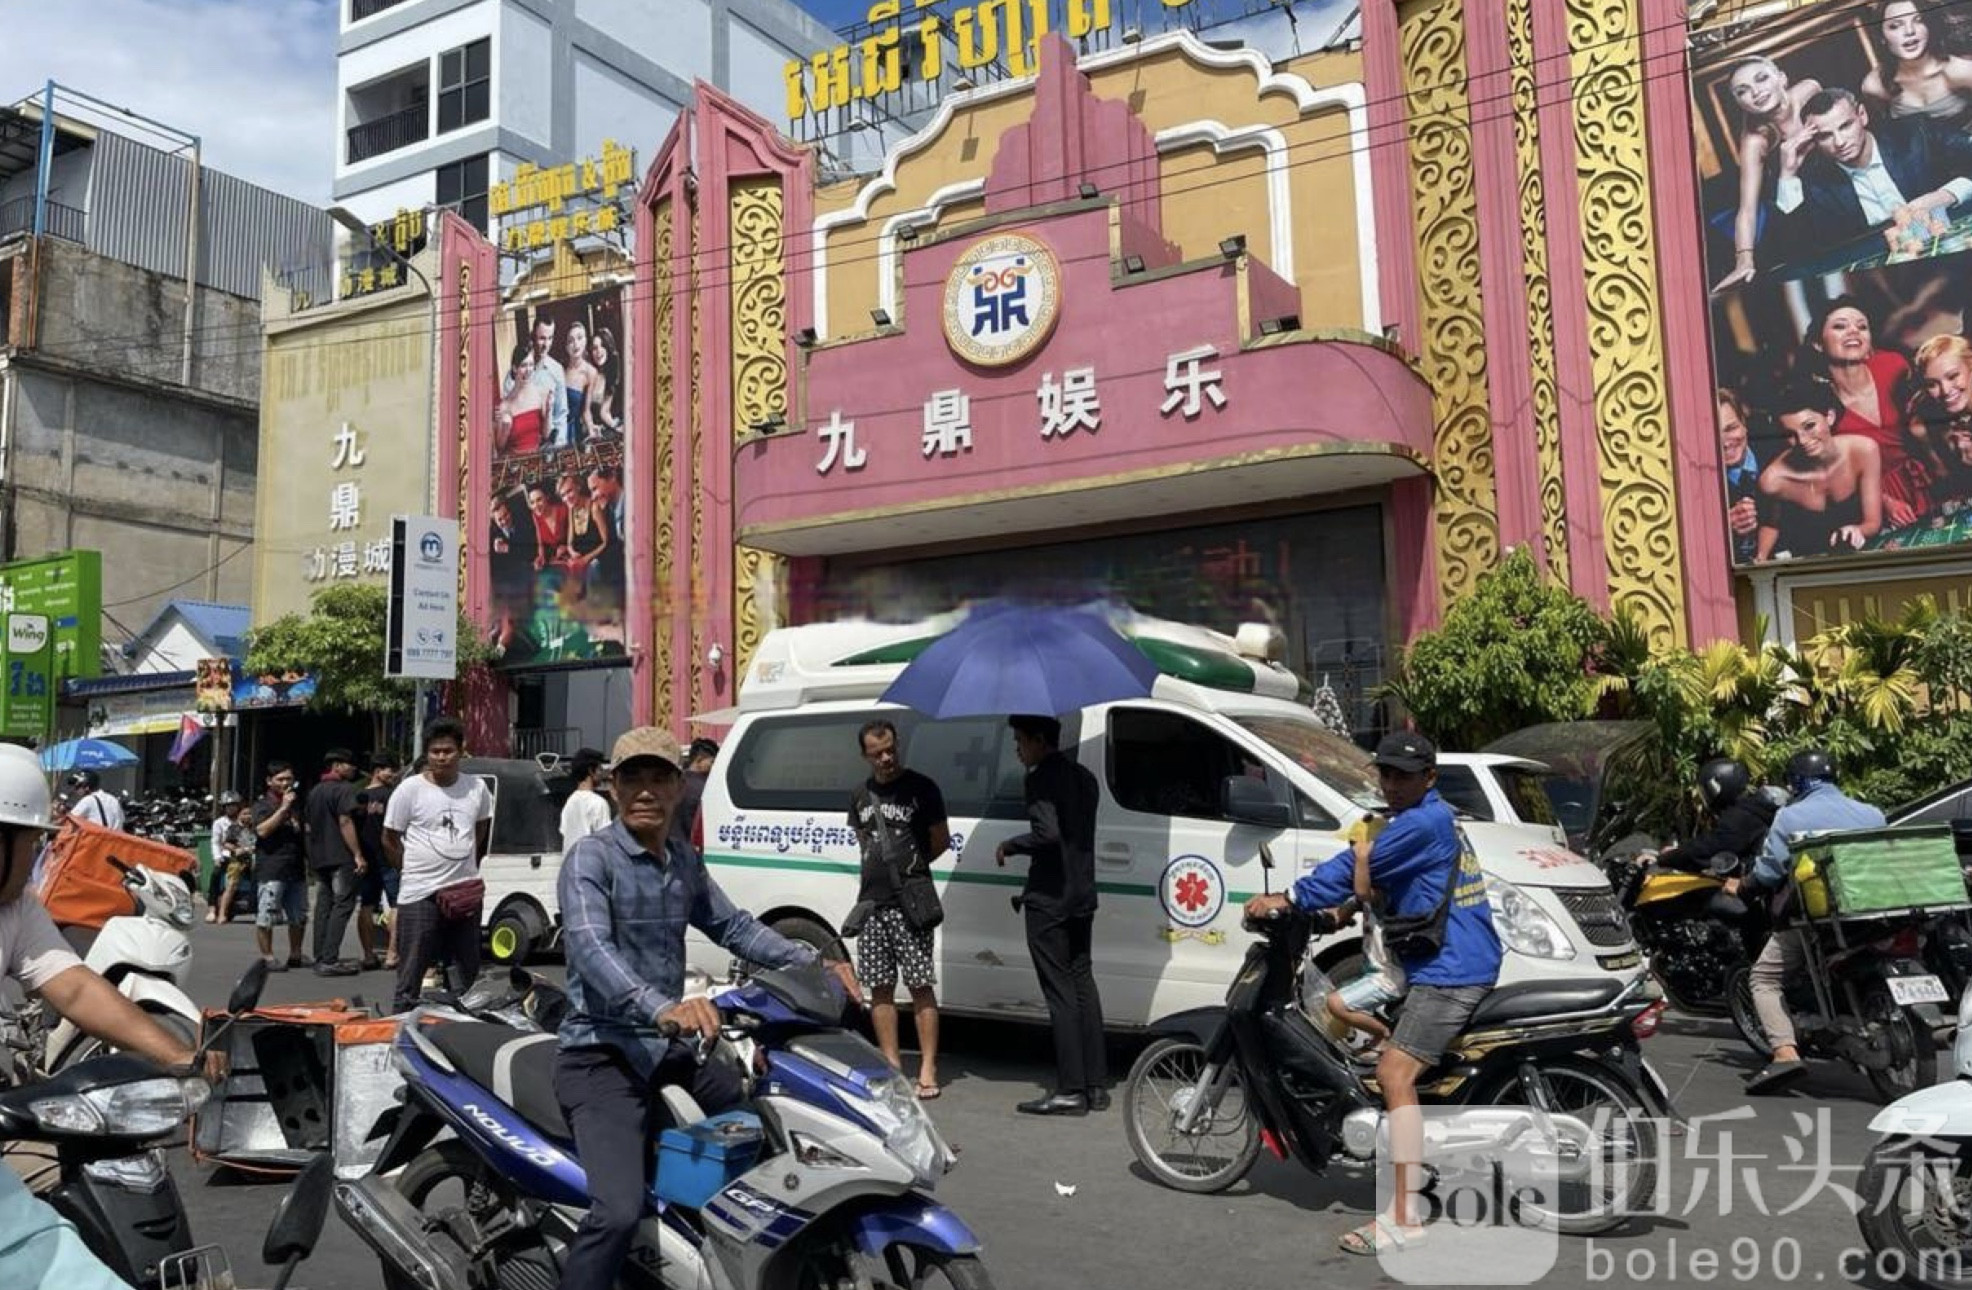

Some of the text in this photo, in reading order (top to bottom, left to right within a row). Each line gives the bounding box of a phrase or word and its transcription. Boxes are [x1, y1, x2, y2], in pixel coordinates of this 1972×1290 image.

[816, 344, 1227, 476] 九鼎娱乐
[329, 422, 365, 531] 九鼎
[12, 627, 46, 642] Wing
[463, 1104, 556, 1166] NOUVO
